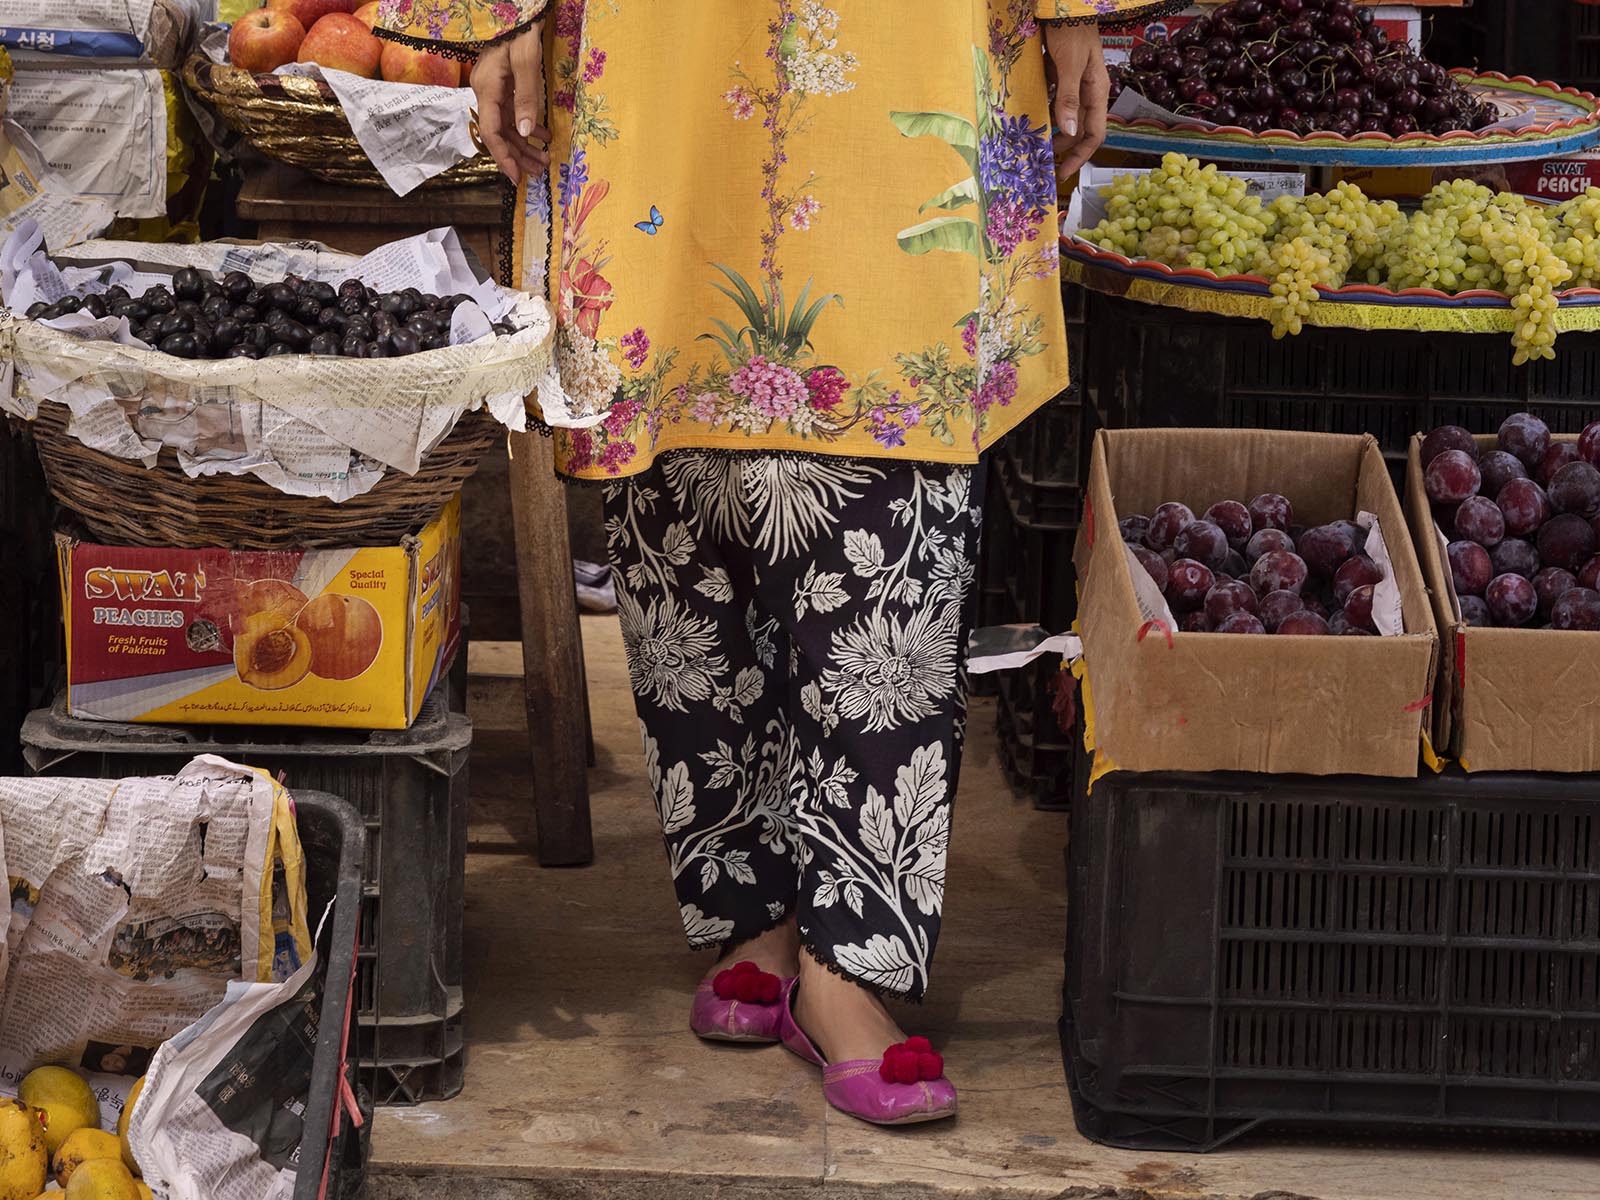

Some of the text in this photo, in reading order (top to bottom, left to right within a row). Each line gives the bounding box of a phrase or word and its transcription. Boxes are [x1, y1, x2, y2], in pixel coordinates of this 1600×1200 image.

[17, 31, 55, 50] 신청
[1543, 162, 1587, 175] SWAT
[1537, 177, 1591, 193] PEACH
[349, 569, 385, 579] Special
[86, 566, 206, 602] SWAT
[349, 580, 387, 590] Quality
[93, 606, 185, 628] PEACHES
[108, 635, 168, 646] Fresh Fruits
[107, 644, 166, 656] of Pakistan
